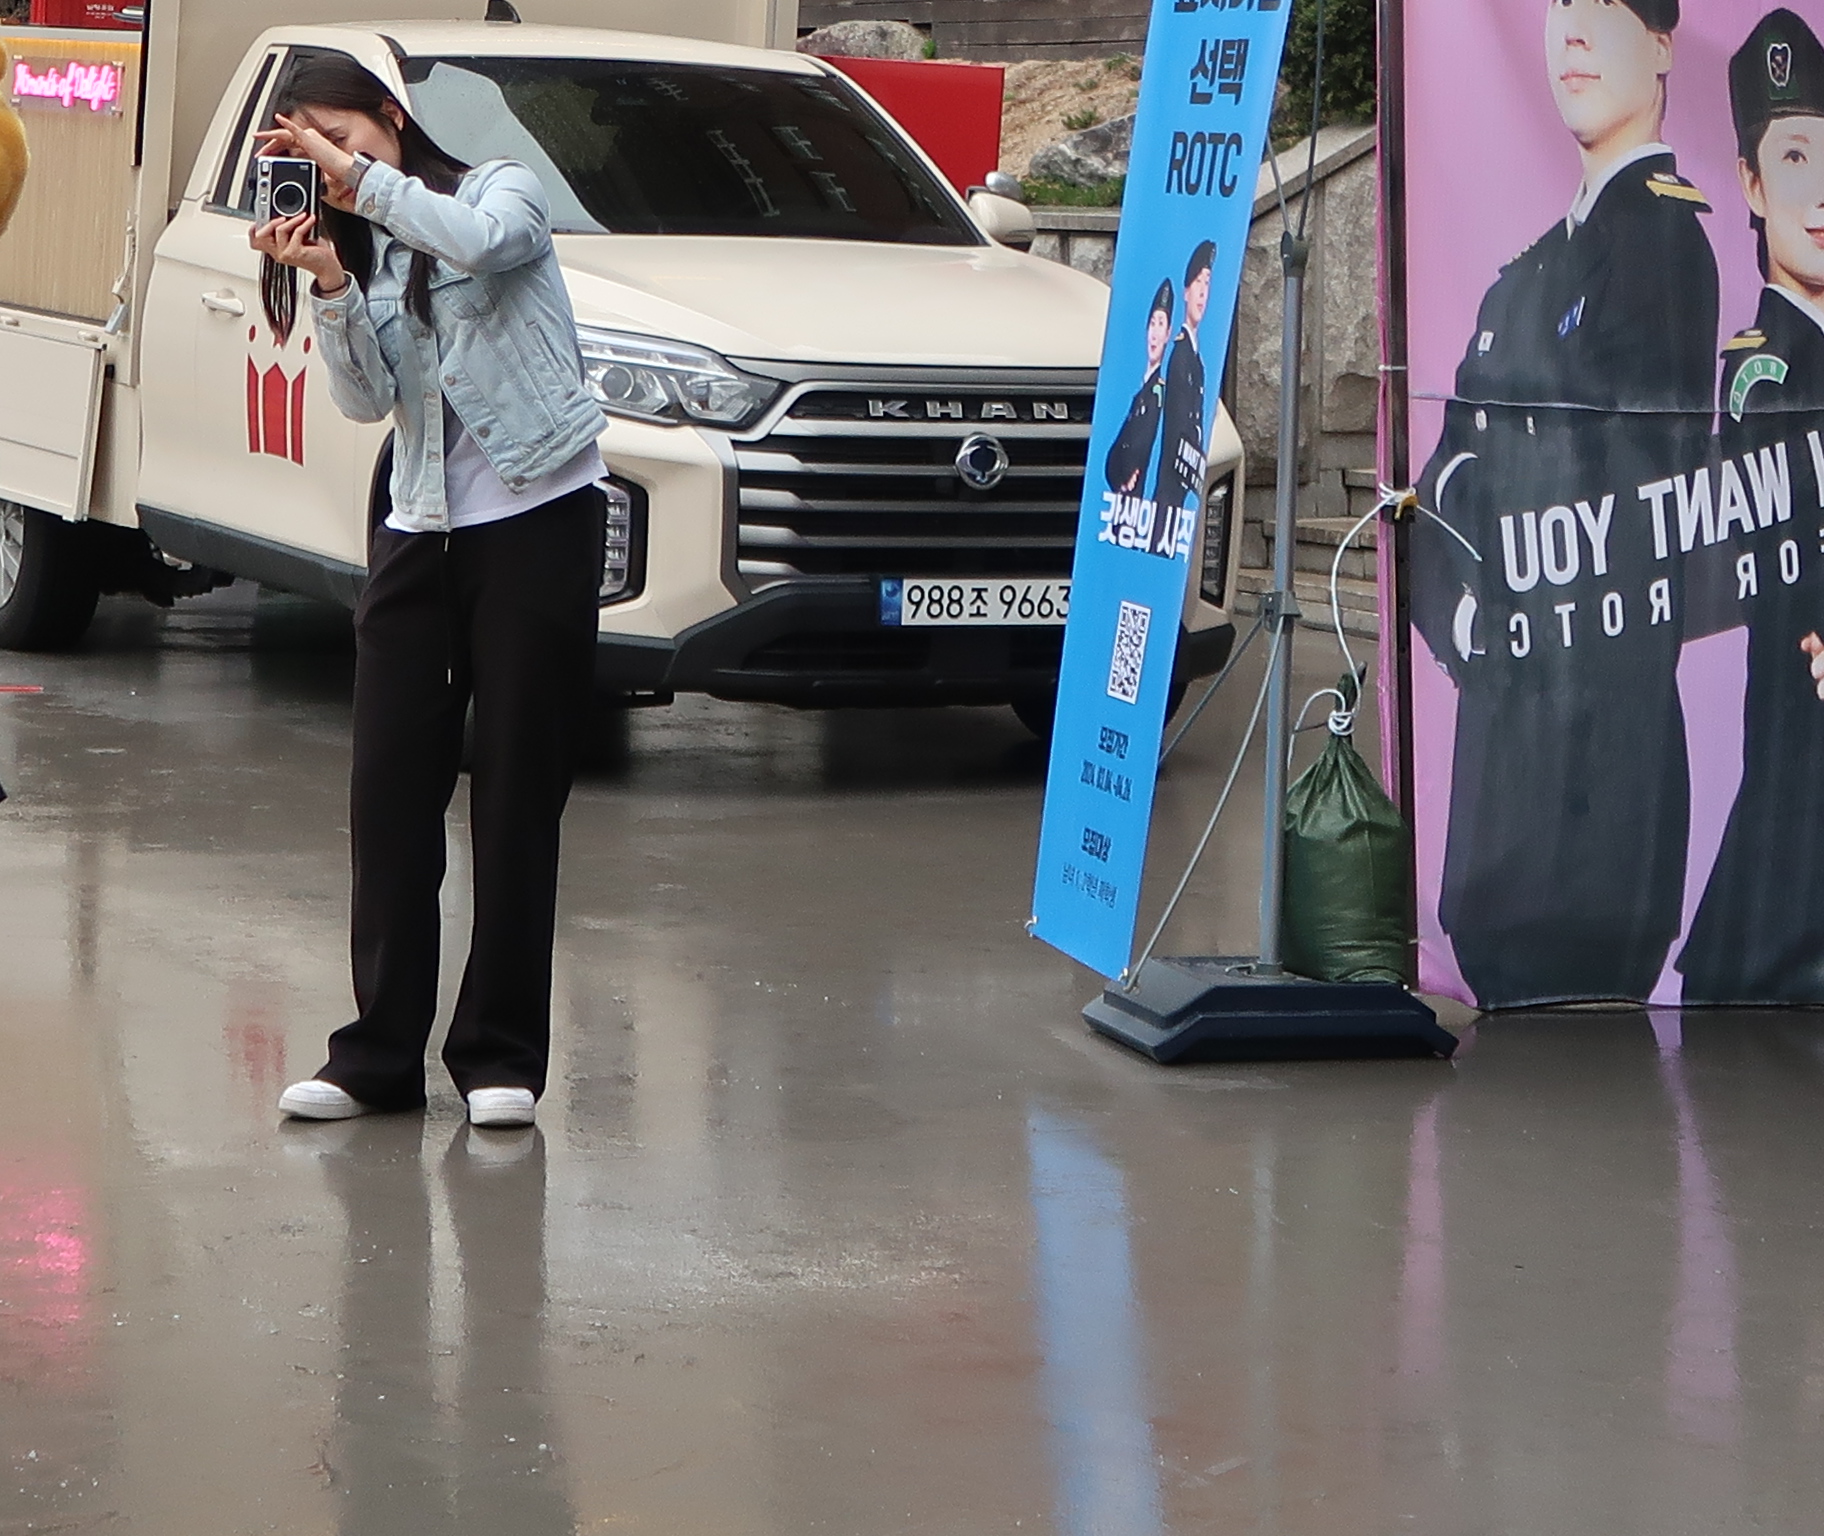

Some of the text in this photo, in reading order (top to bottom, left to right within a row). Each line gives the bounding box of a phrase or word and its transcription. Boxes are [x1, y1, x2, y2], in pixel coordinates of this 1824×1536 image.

[1189, 39, 1249, 105] 선택
[1165, 131, 1243, 198] ROTC
[869, 400, 1069, 420] KHAN
[1098, 491, 1157, 552] 갓생의
[907, 585, 1072, 619] 988조 9663
